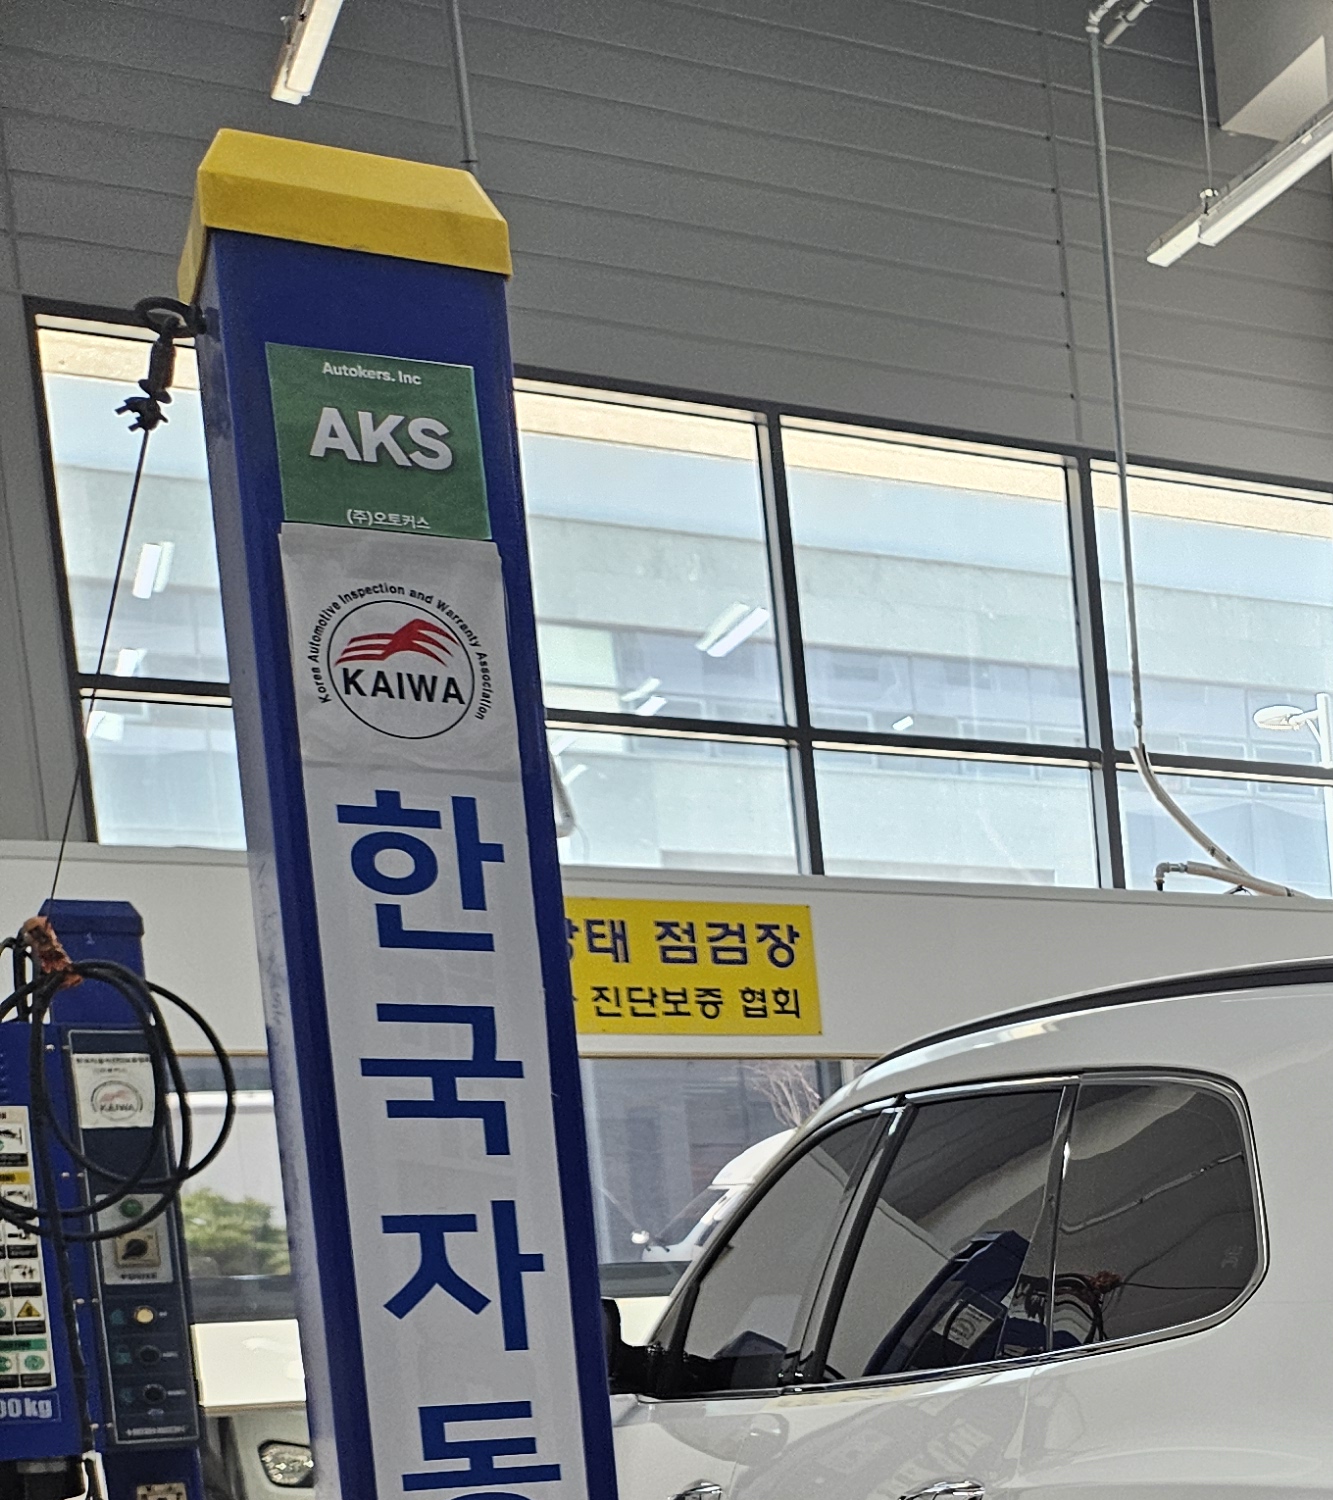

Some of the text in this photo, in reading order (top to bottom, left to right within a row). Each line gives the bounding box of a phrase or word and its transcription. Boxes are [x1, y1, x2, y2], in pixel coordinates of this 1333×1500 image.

[398, 370, 422, 386] Inc
[309, 406, 453, 471] AKS
[346, 509, 430, 529] (주)오토커스
[307, 603, 341, 663] Automotive
[340, 582, 405, 605] Inspection
[409, 588, 434, 605] and
[435, 599, 482, 648] Warranty
[475, 650, 494, 720] Association
[342, 667, 466, 705] KAIWA
[653, 919, 800, 969] 점검장
[590, 985, 801, 1020] 진단보증 협회
